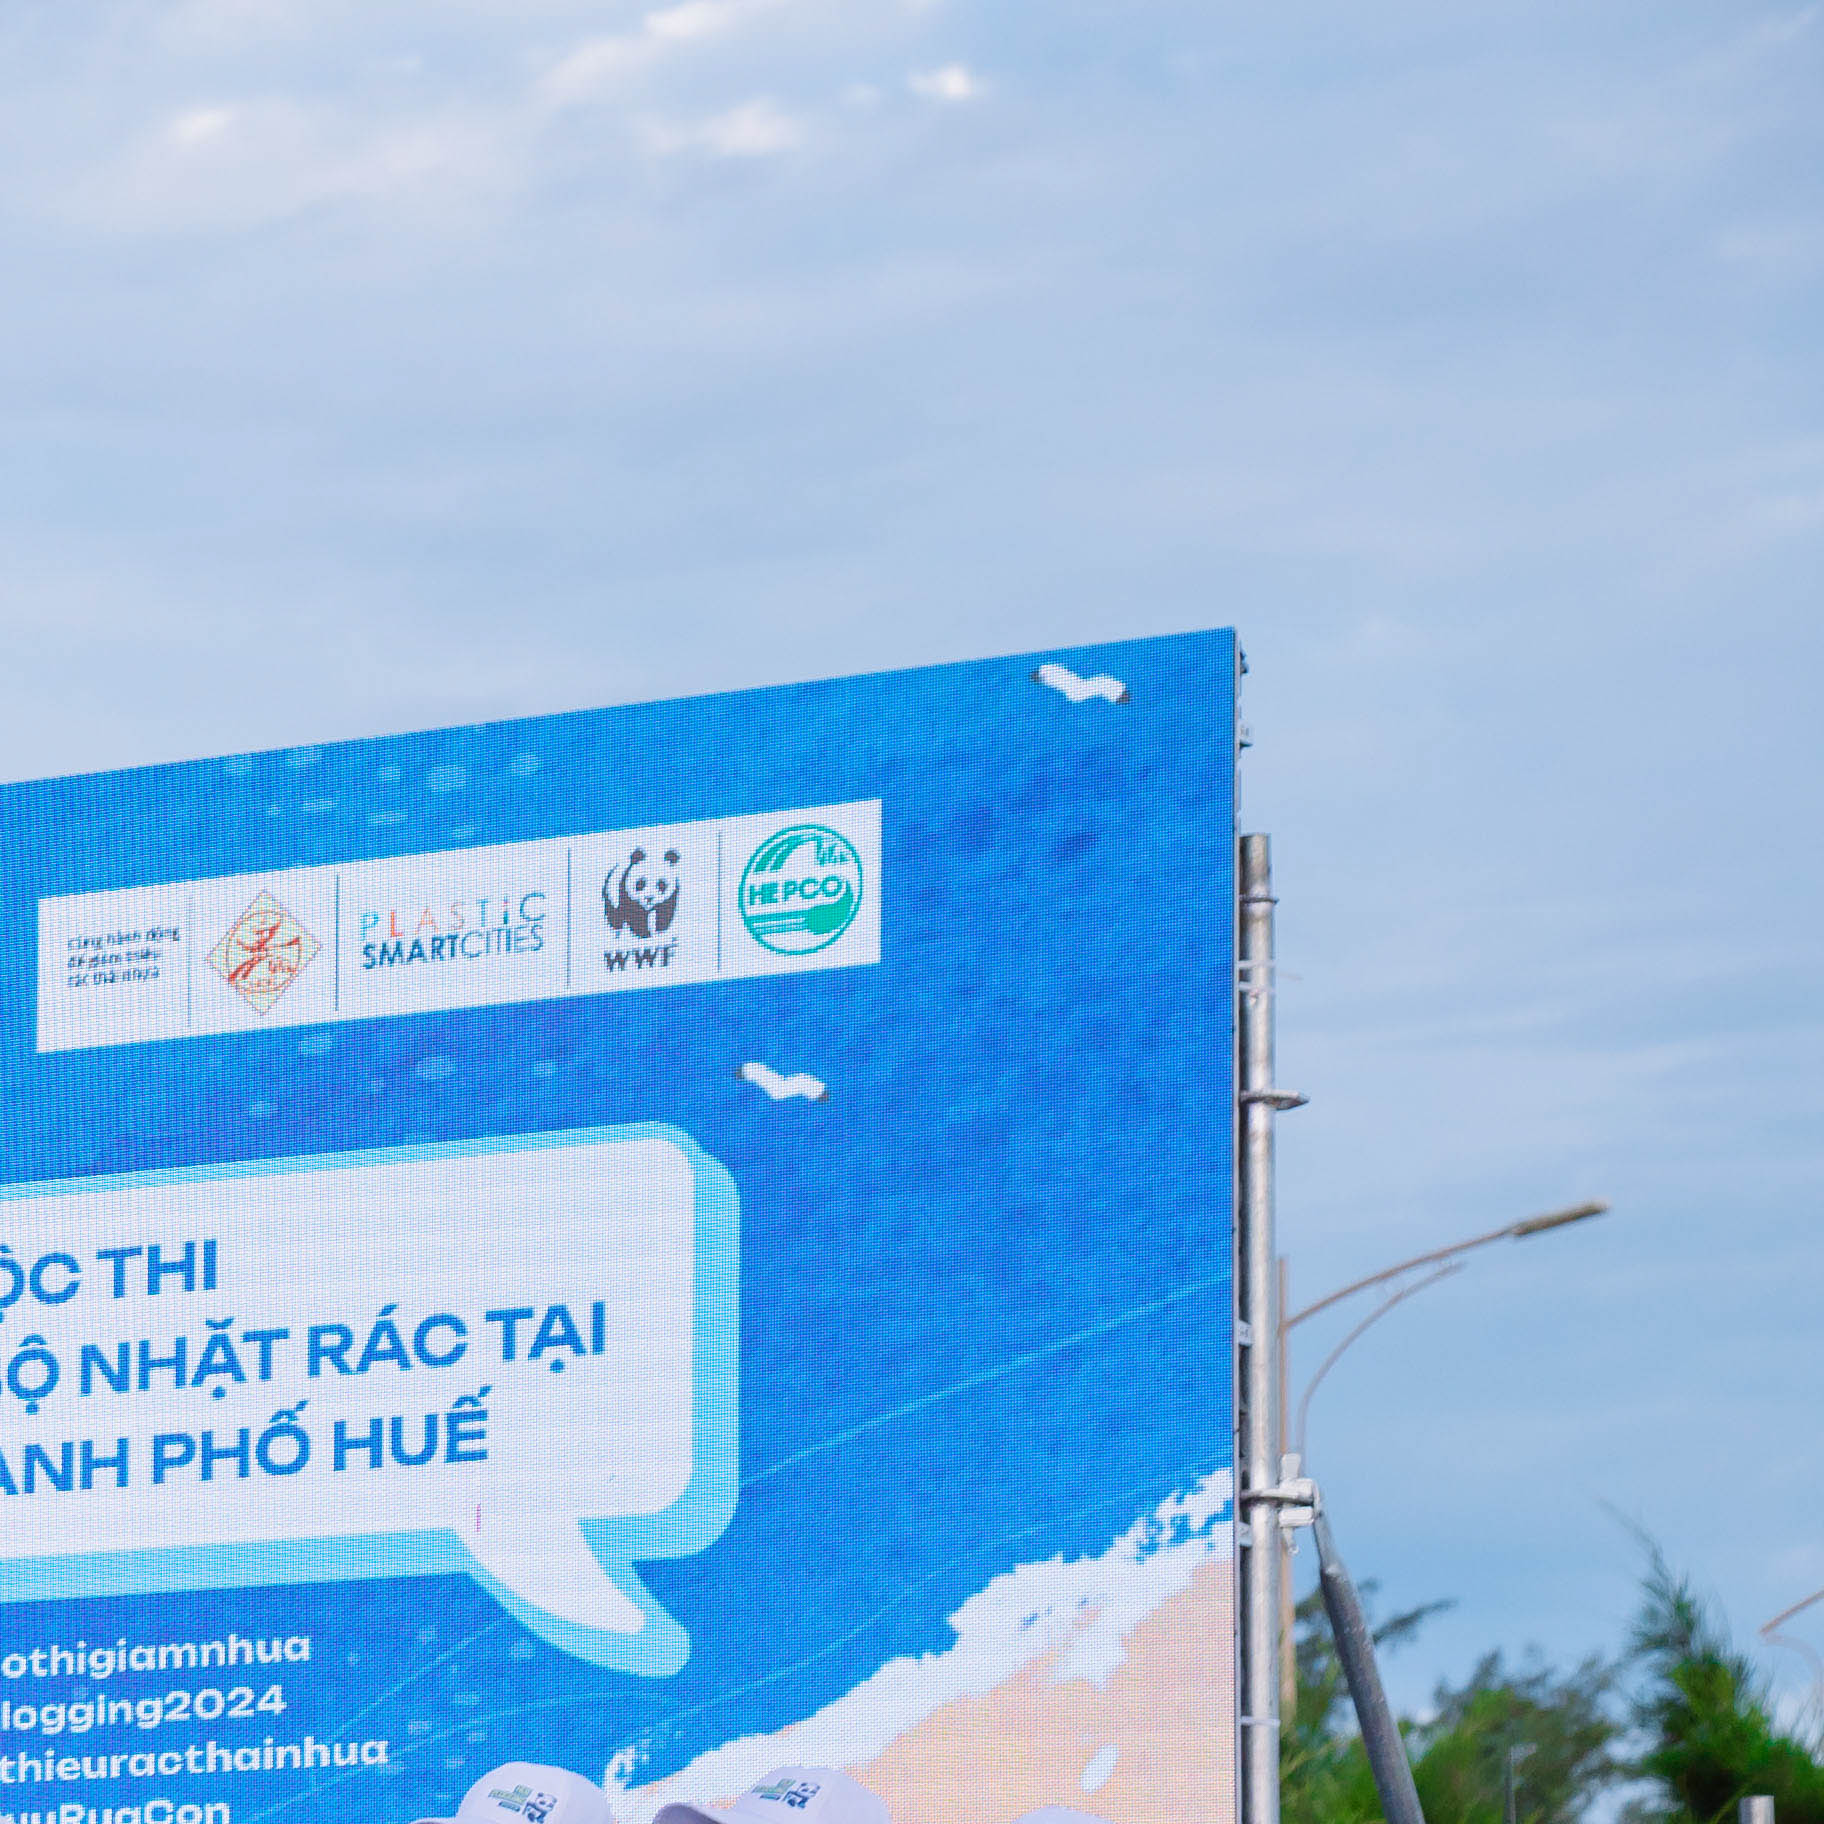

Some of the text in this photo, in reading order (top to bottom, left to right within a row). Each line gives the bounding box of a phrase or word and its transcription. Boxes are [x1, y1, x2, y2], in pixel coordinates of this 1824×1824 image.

[748, 873, 843, 906] HEPCO
[603, 938, 679, 972] WWF
[96, 1239, 217, 1299] THI
[80, 1316, 290, 1400] NHẶT
[307, 1302, 469, 1379] RÁC
[485, 1300, 605, 1374] TẠI
[152, 1399, 311, 1485] PHỐ
[333, 1385, 493, 1472] HUẾ
